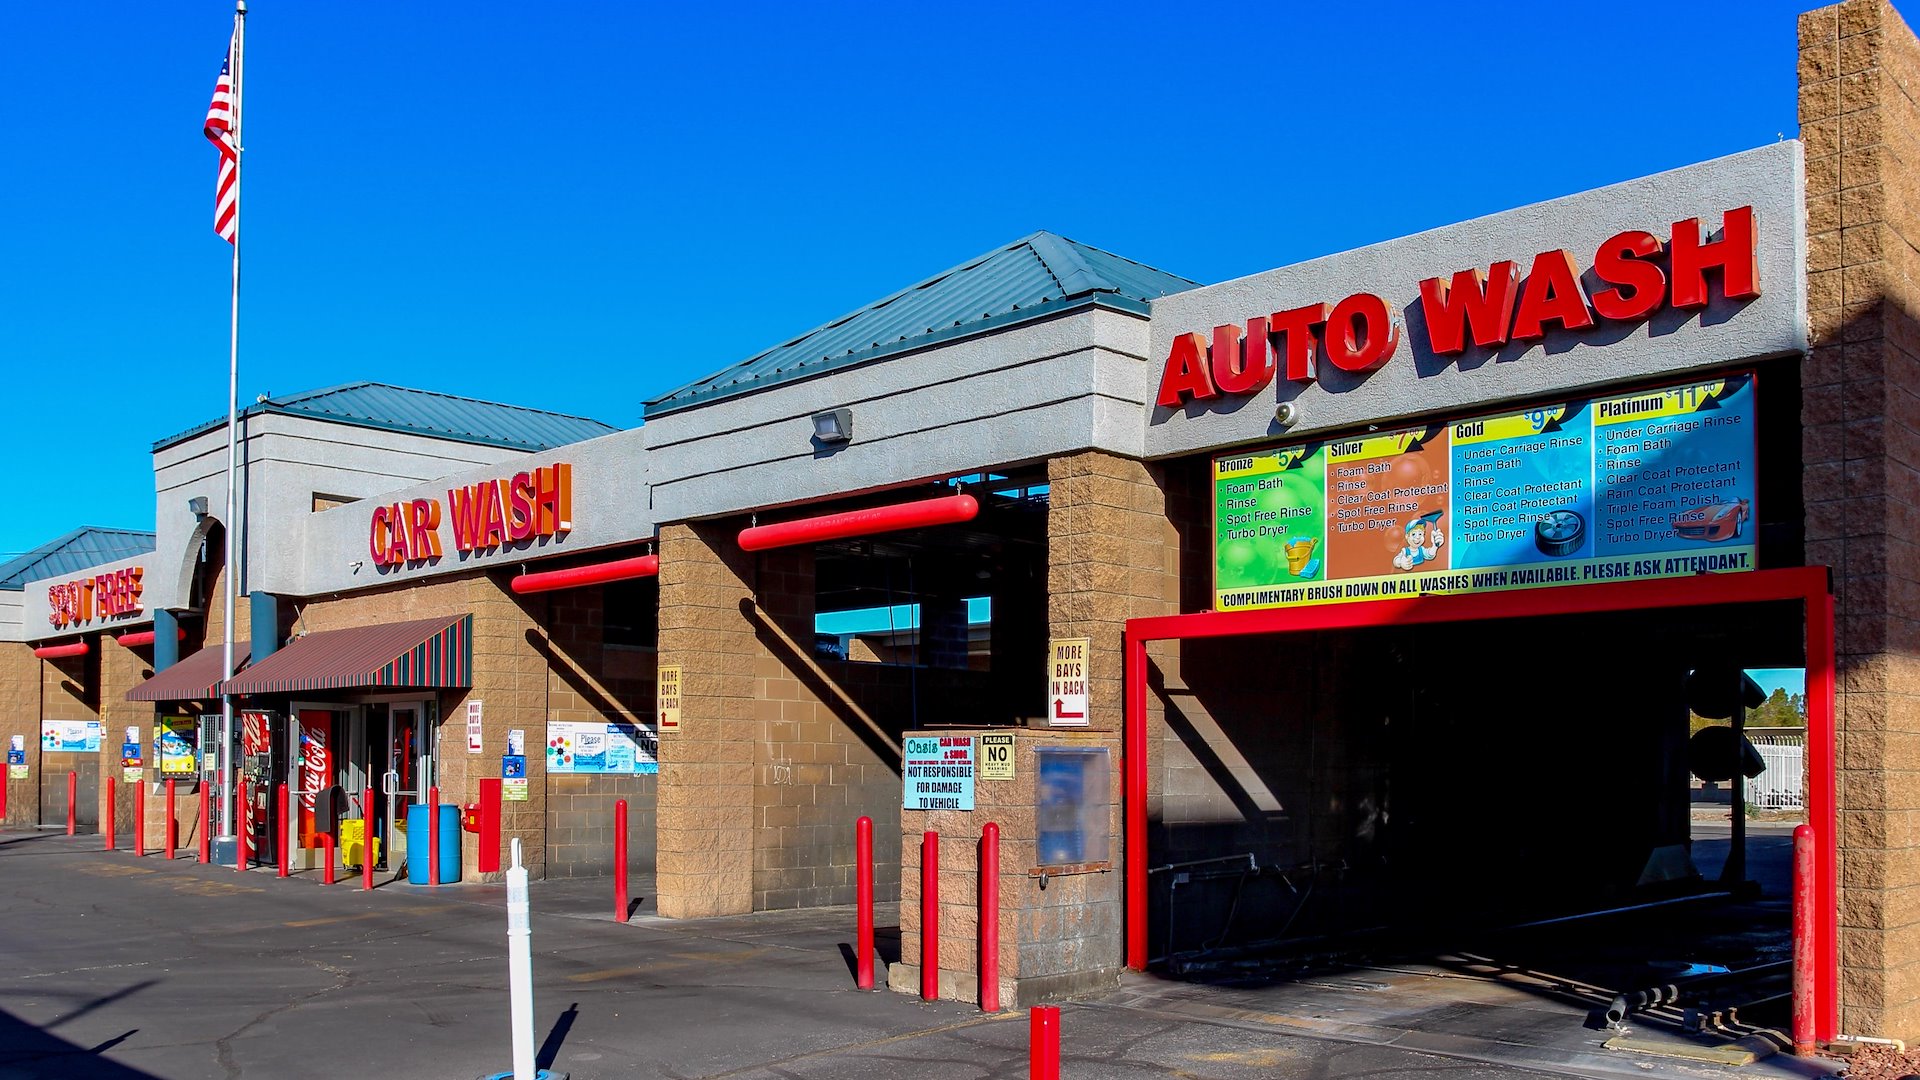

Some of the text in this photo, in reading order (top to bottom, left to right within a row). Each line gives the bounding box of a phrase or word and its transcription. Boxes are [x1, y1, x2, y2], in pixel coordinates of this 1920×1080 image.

[1157, 205, 1761, 406] AUTO WASH
[1600, 397, 1662, 417] Platinum
[1457, 422, 1483, 438] Gold
[1607, 415, 1741, 440] Under Carriage Rinse
[1332, 442, 1363, 456] Silver
[1464, 437, 1582, 459] Under Carriage Rinse
[1607, 438, 1671, 455] Foam Bath
[1220, 459, 1253, 472] Bronze
[1338, 463, 1391, 477] Foam Bath
[1464, 459, 1521, 473] Foam Bath
[1607, 459, 1640, 469] Rinse
[1607, 461, 1740, 485] Clear Coat Protectant
[1227, 478, 1282, 494] Foam Bath
[1338, 481, 1365, 491] Rinse
[1465, 477, 1494, 487] Rinse
[1608, 477, 1735, 500] Rain Coat Protectant
[1338, 484, 1448, 504] Clear Coat Protectant
[1465, 480, 1581, 501] Clear Coat Protectant
[1227, 498, 1256, 509] Rinse
[1338, 502, 1418, 519] Spot Free Rinse
[1465, 494, 1577, 515] Rain Coat Protectant
[1607, 494, 1719, 515] Triple Foam Polish
[370, 463, 571, 565] CAR WASH
[1227, 507, 1311, 526] Spot Free Rinse
[1465, 512, 1551, 530] Spot Free Rinse
[1607, 512, 1704, 530] Spot Free Rinse
[1227, 525, 1288, 539] Turbo Dryer
[1338, 519, 1395, 532] Turbo Dryer
[1465, 529, 1526, 542] Turbo Dryer
[1608, 529, 1678, 543] Turbo Dryer
[1308, 585, 1342, 600] BRUSH
[1347, 583, 1377, 597] DOWN
[1382, 581, 1396, 594] ON
[1400, 579, 1417, 593] ALL
[1420, 574, 1469, 591] WASHES
[1472, 571, 1507, 588] WHEN
[1511, 567, 1580, 585] AVAILABLE.
[1584, 562, 1630, 579] PLESAE
[1633, 559, 1660, 575] ASK
[1664, 553, 1749, 573] ATTENDANT.
[49, 566, 144, 625] SPOT FREE
[1057, 646, 1081, 659] MORE
[662, 671, 677, 681] MORE
[1057, 663, 1080, 677] BAYS
[662, 684, 677, 695] BAYS
[1053, 681, 1084, 695] IN BACK
[660, 698, 678, 708] IN BACK
[581, 735, 600, 743] Please
[908, 737, 970, 753] Oasis CAR WASH
[989, 747, 1007, 761] NO
[908, 767, 972, 777] NOT RESPONSIBLE
[917, 782, 962, 793] FOR DAMAGE
[919, 798, 959, 808] TO VEHICLE
